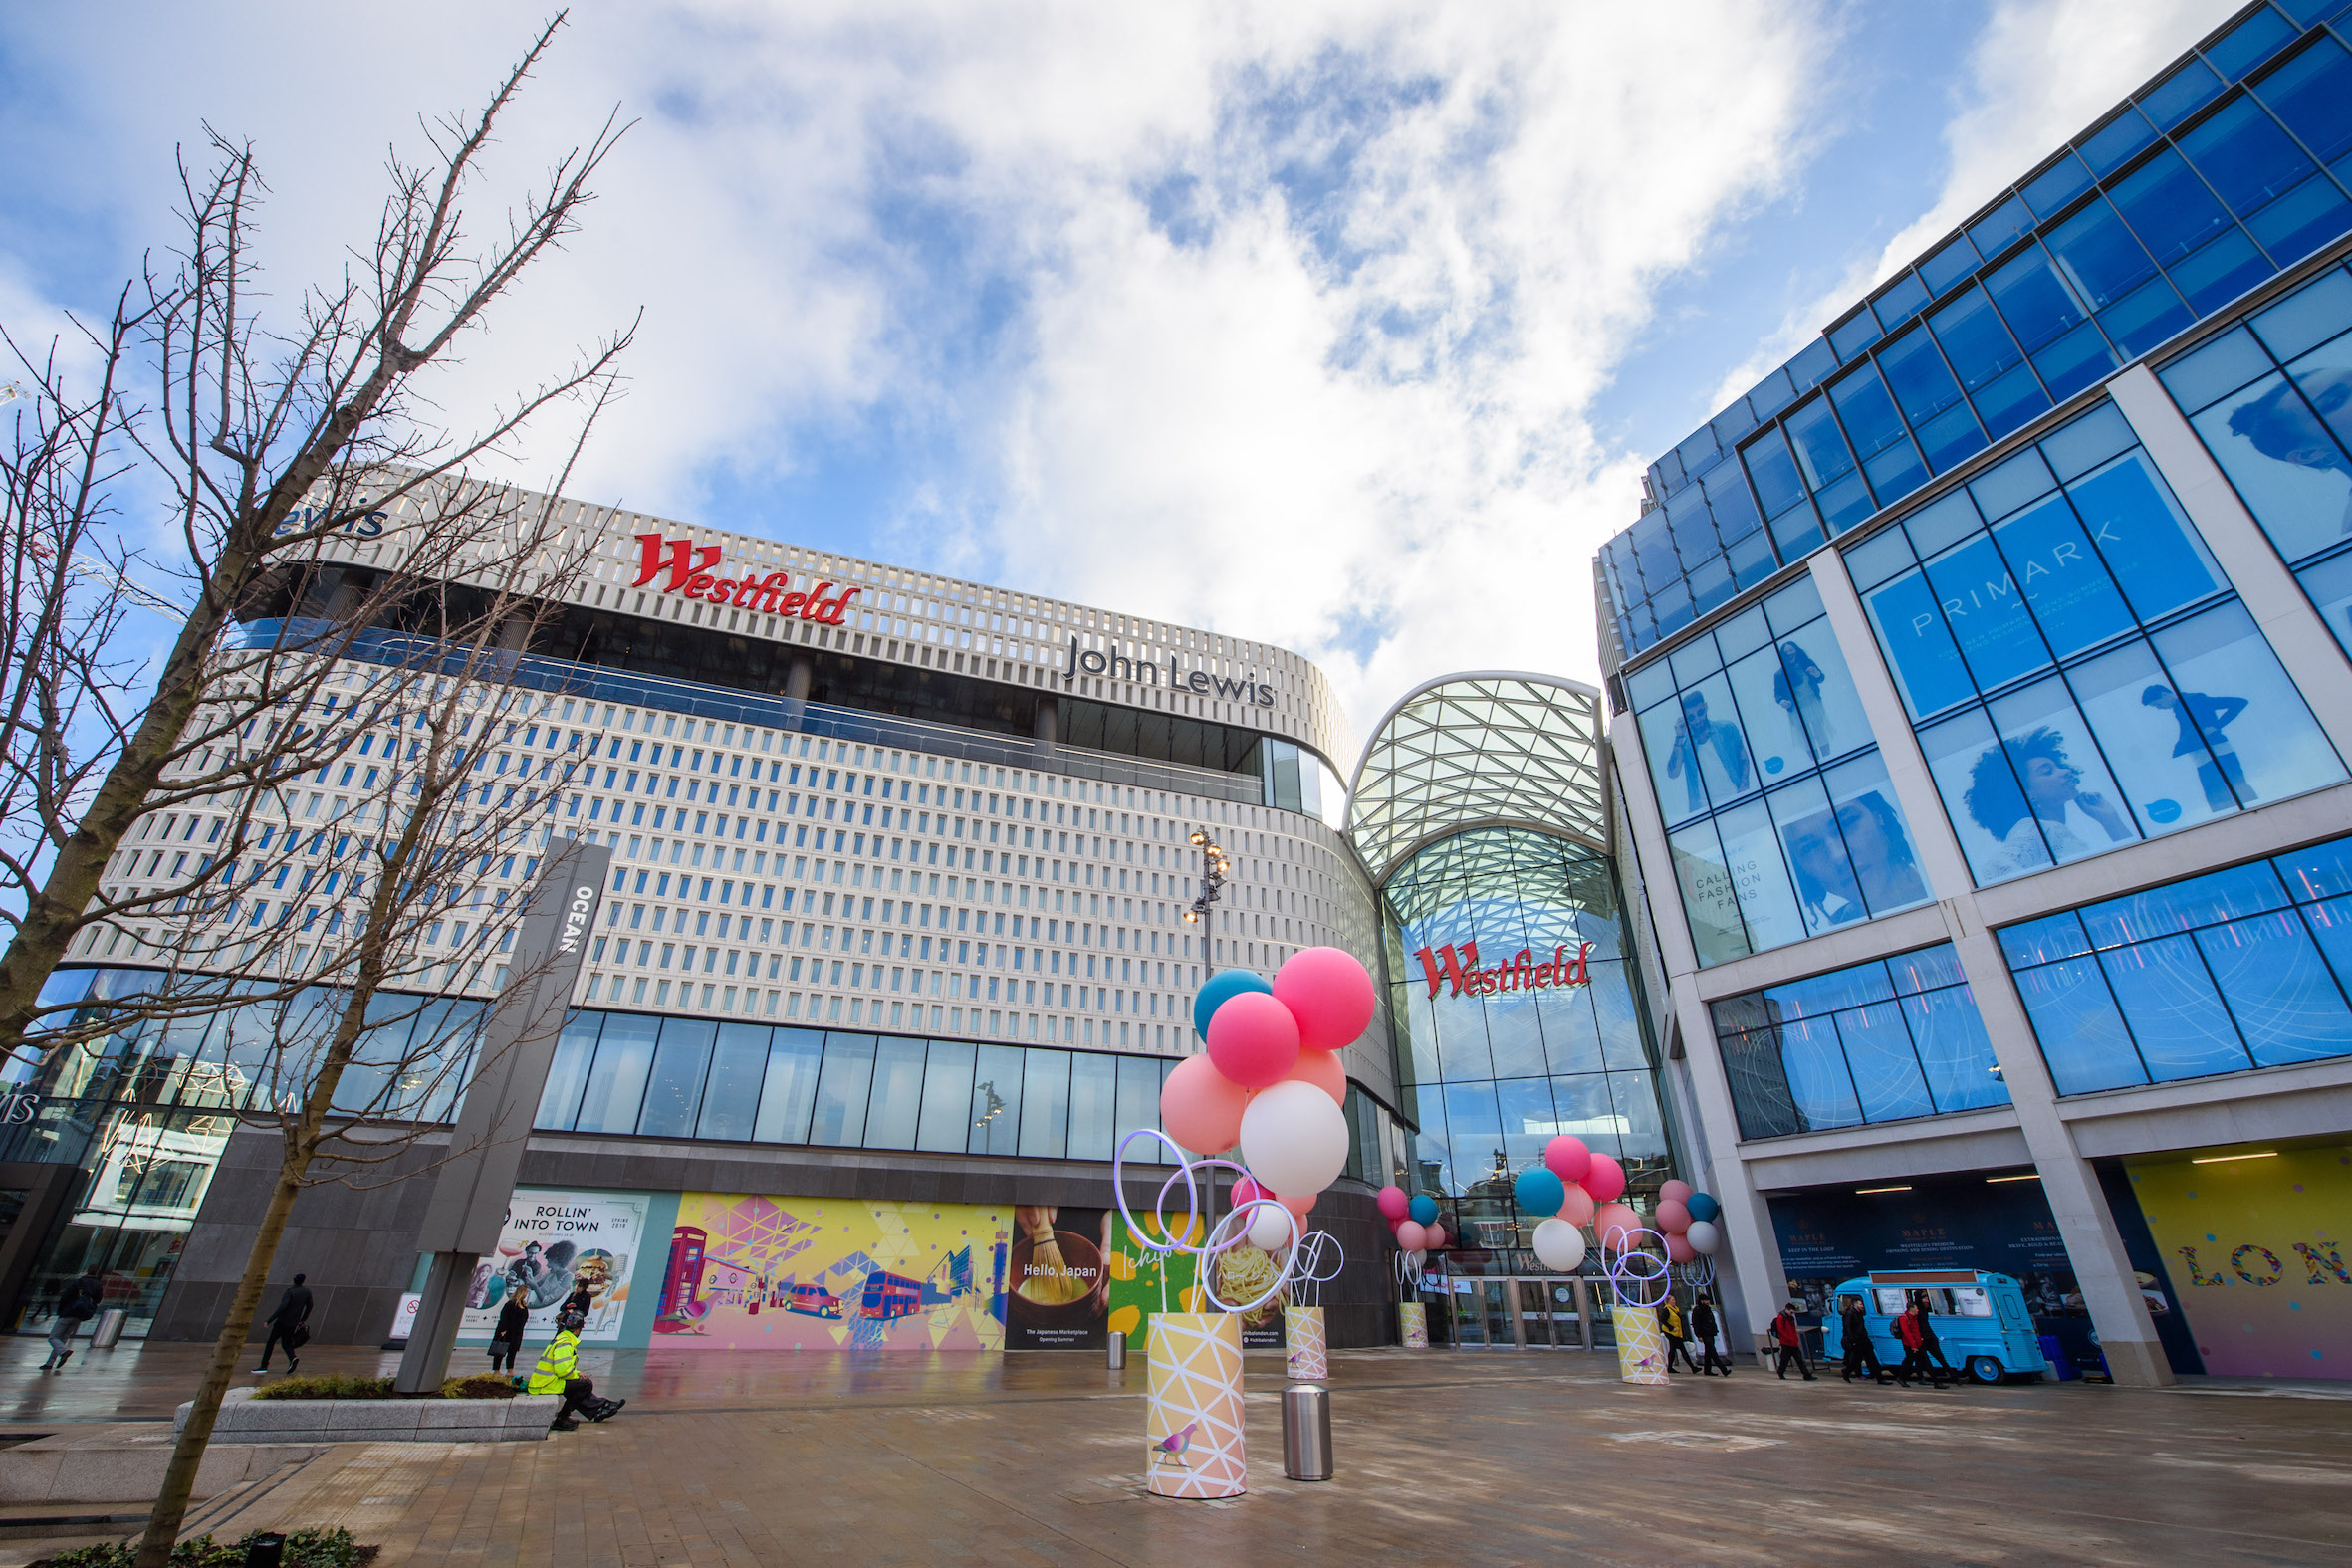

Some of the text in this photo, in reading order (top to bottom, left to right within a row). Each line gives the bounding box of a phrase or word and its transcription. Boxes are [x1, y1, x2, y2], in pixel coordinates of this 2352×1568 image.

[274, 498, 388, 536] ewis
[631, 533, 861, 626] Westfield
[1912, 521, 2122, 638] PRIMARK
[1061, 634, 1276, 708] John Lewis
[1696, 860, 1757, 889] CALLING
[1698, 873, 1761, 902] FASHION
[1717, 889, 1757, 910] FANS
[559, 886, 593, 953] OCEAN
[1413, 940, 1593, 1000] Westfield
[514, 1219, 599, 1232] INTO TOWN
[536, 1206, 591, 1219] ROLLIN'
[1902, 1228, 1946, 1236] MAPLE
[1024, 1263, 1097, 1279] Hello, Japan
